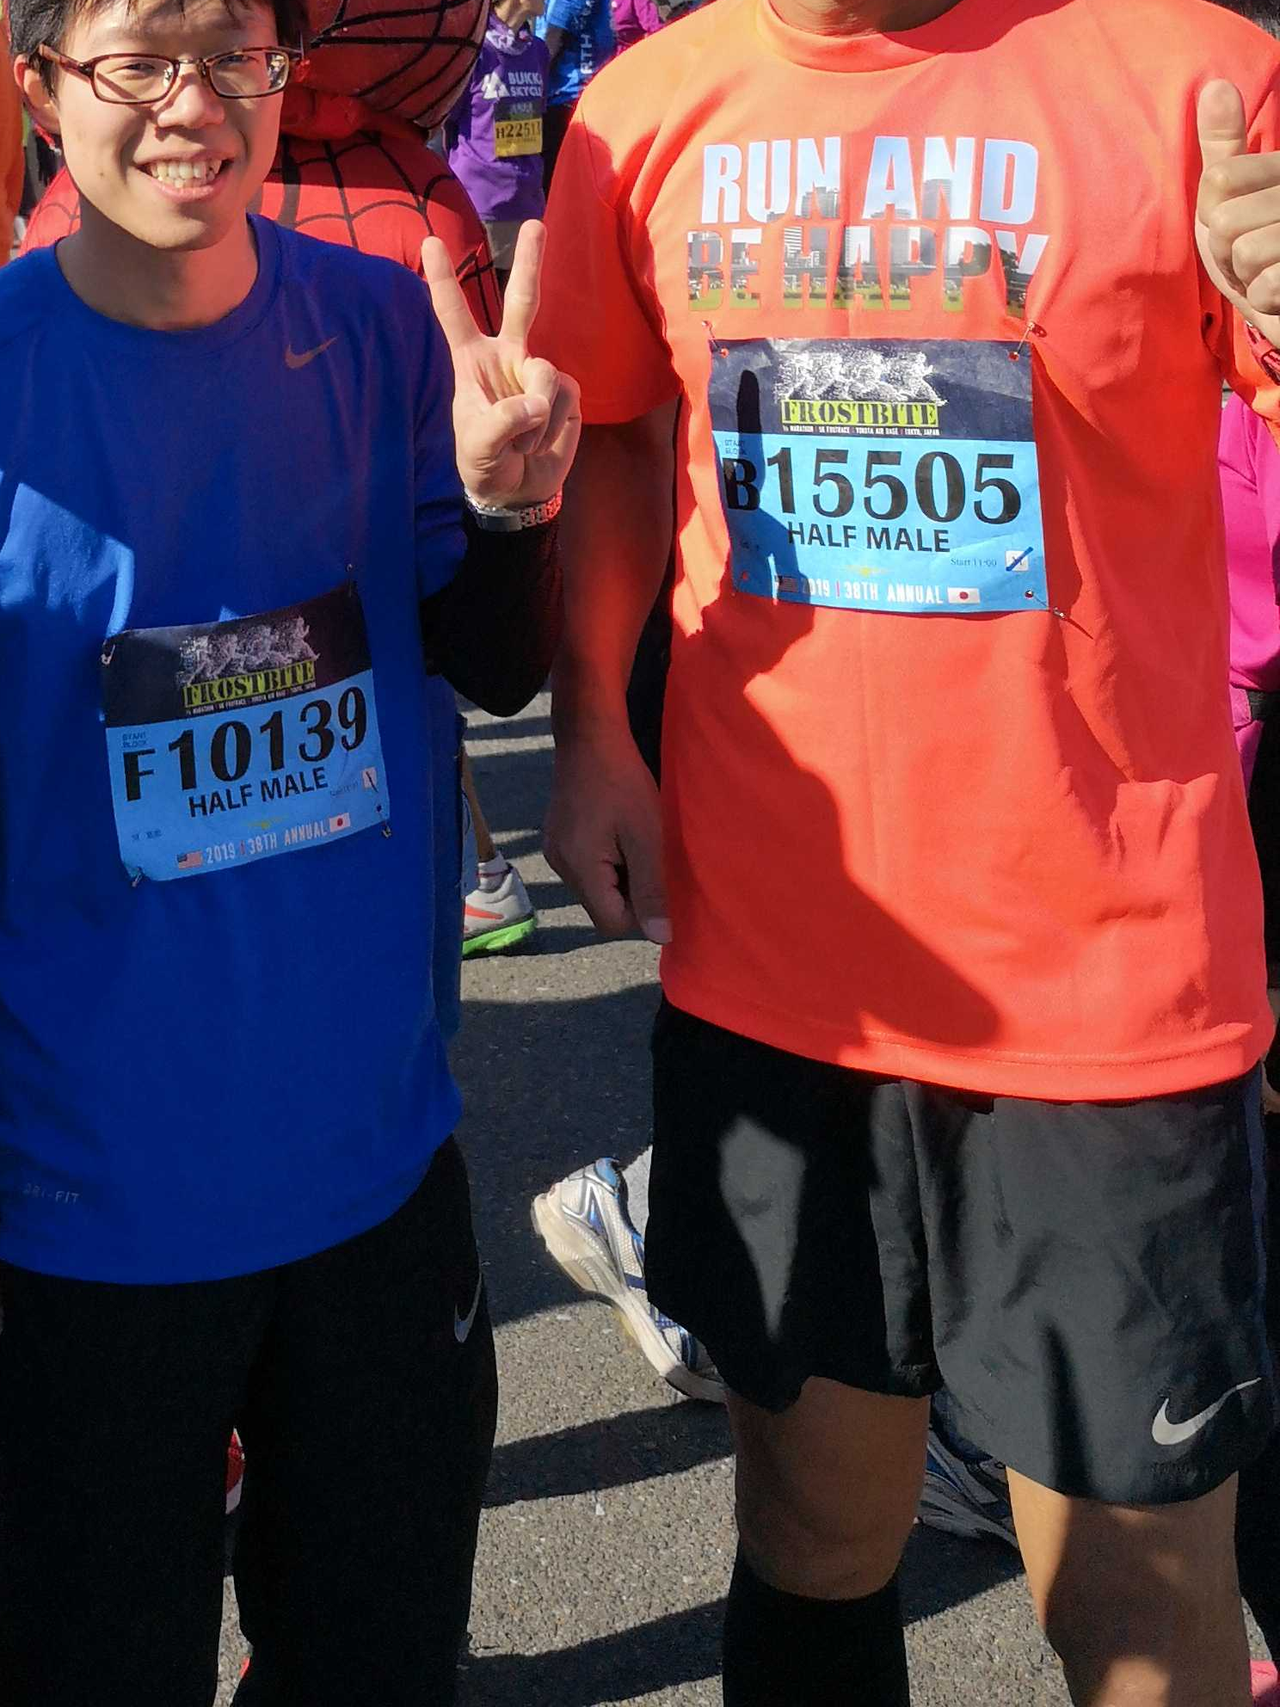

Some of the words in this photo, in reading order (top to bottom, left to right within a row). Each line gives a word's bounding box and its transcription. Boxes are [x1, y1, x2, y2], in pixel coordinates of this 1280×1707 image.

[700, 137, 842, 224] RUN
[862, 135, 1040, 225] AND
[688, 228, 763, 311] BE
[783, 225, 1050, 319] HAPPY
[783, 400, 937, 426] FROSTBITE
[766, 446, 1022, 525] 15505
[787, 521, 858, 548] HALF
[866, 525, 951, 553] MALE
[844, 581, 879, 601] 38TH
[887, 584, 944, 605] ANNUAL
[185, 661, 315, 706] FROSTBITE
[168, 686, 367, 791] 10139
[188, 784, 253, 818] HALF
[260, 767, 329, 803] MALE
[205, 843, 236, 864] 2019
[248, 832, 278, 855] 38TH
[284, 820, 328, 847] ANNUAL
